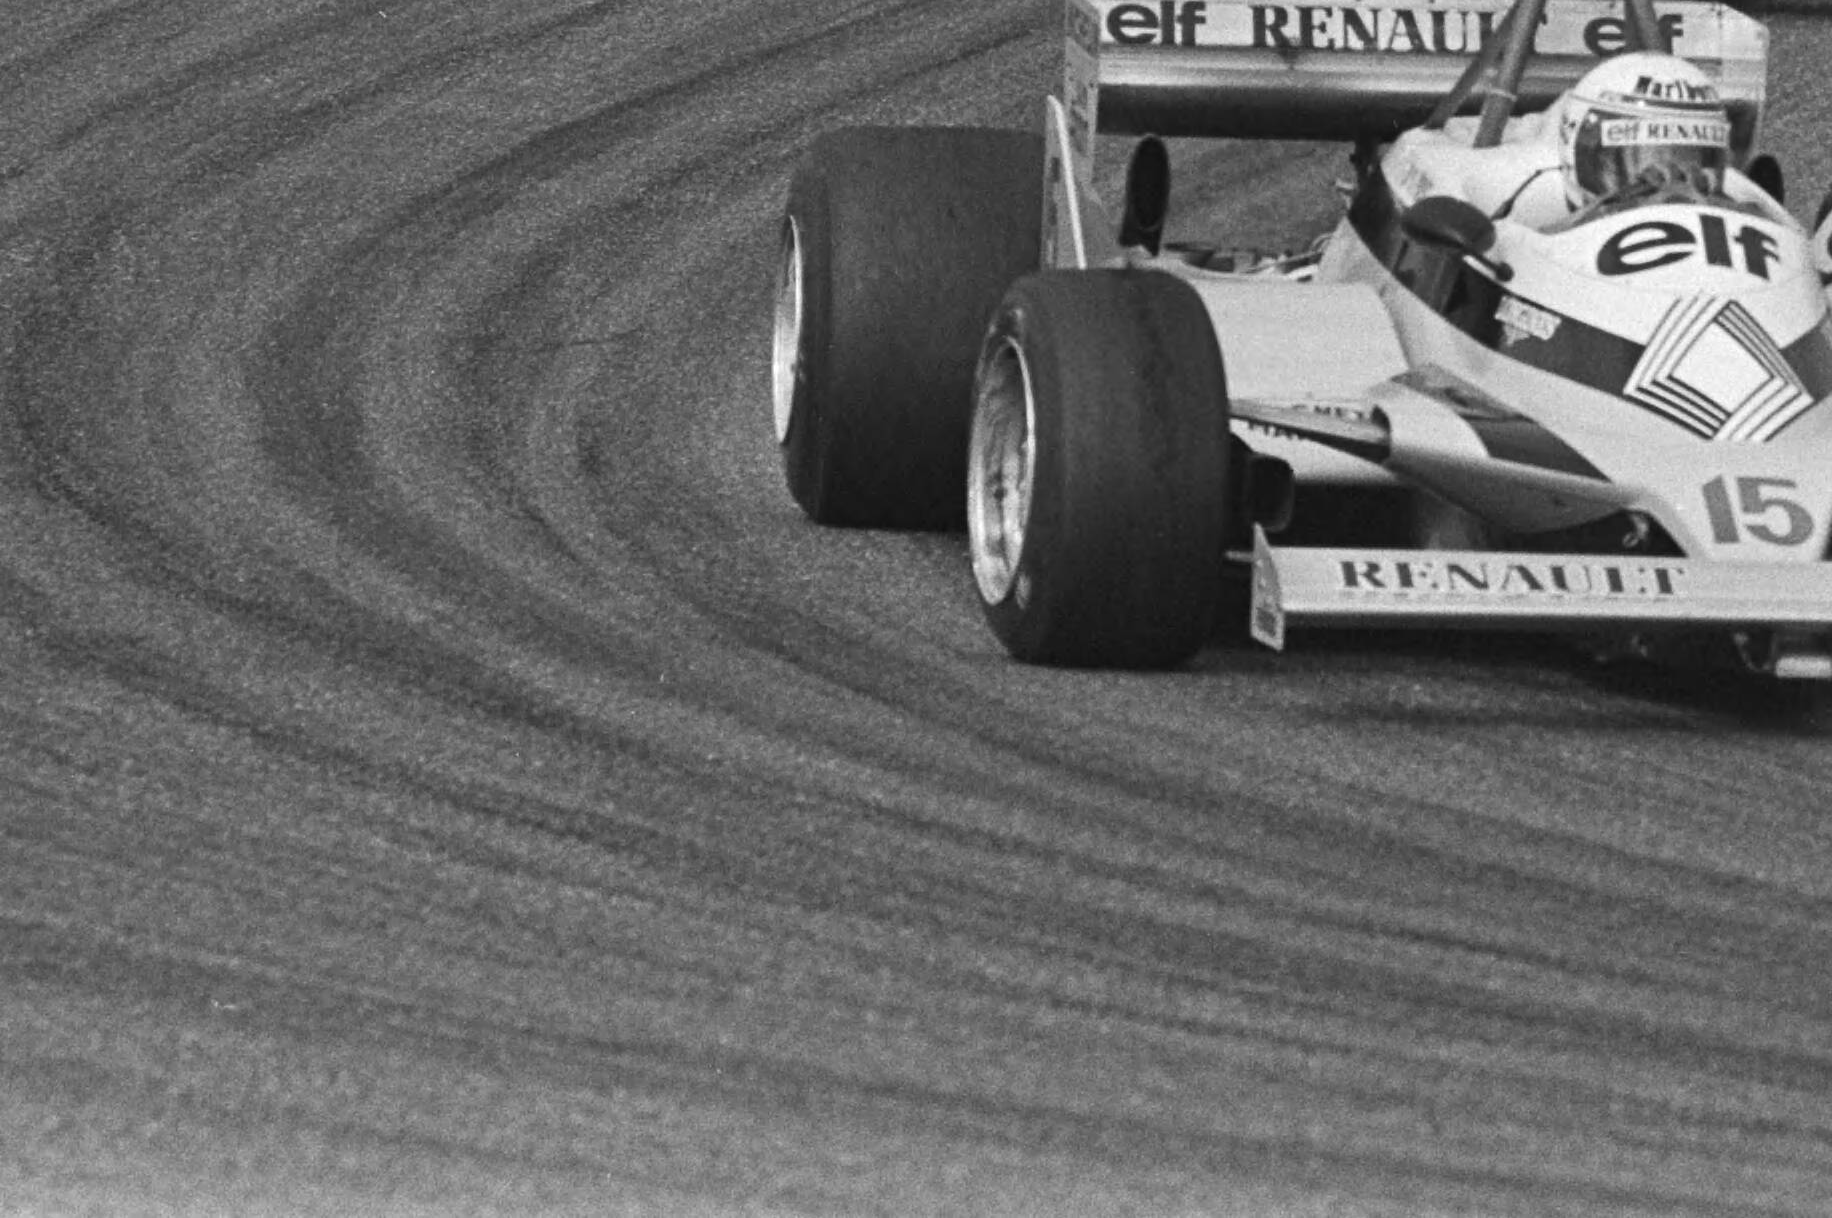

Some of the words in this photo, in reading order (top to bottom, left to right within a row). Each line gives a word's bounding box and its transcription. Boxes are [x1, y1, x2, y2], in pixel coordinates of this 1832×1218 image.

[1106, 0, 1207, 47] elf
[1251, 5, 1548, 53] RENAU
[1583, 13, 1684, 57] ef
[1596, 213, 1780, 282] elf
[1702, 474, 1815, 547] 15
[1339, 560, 1685, 595] RENAULT
